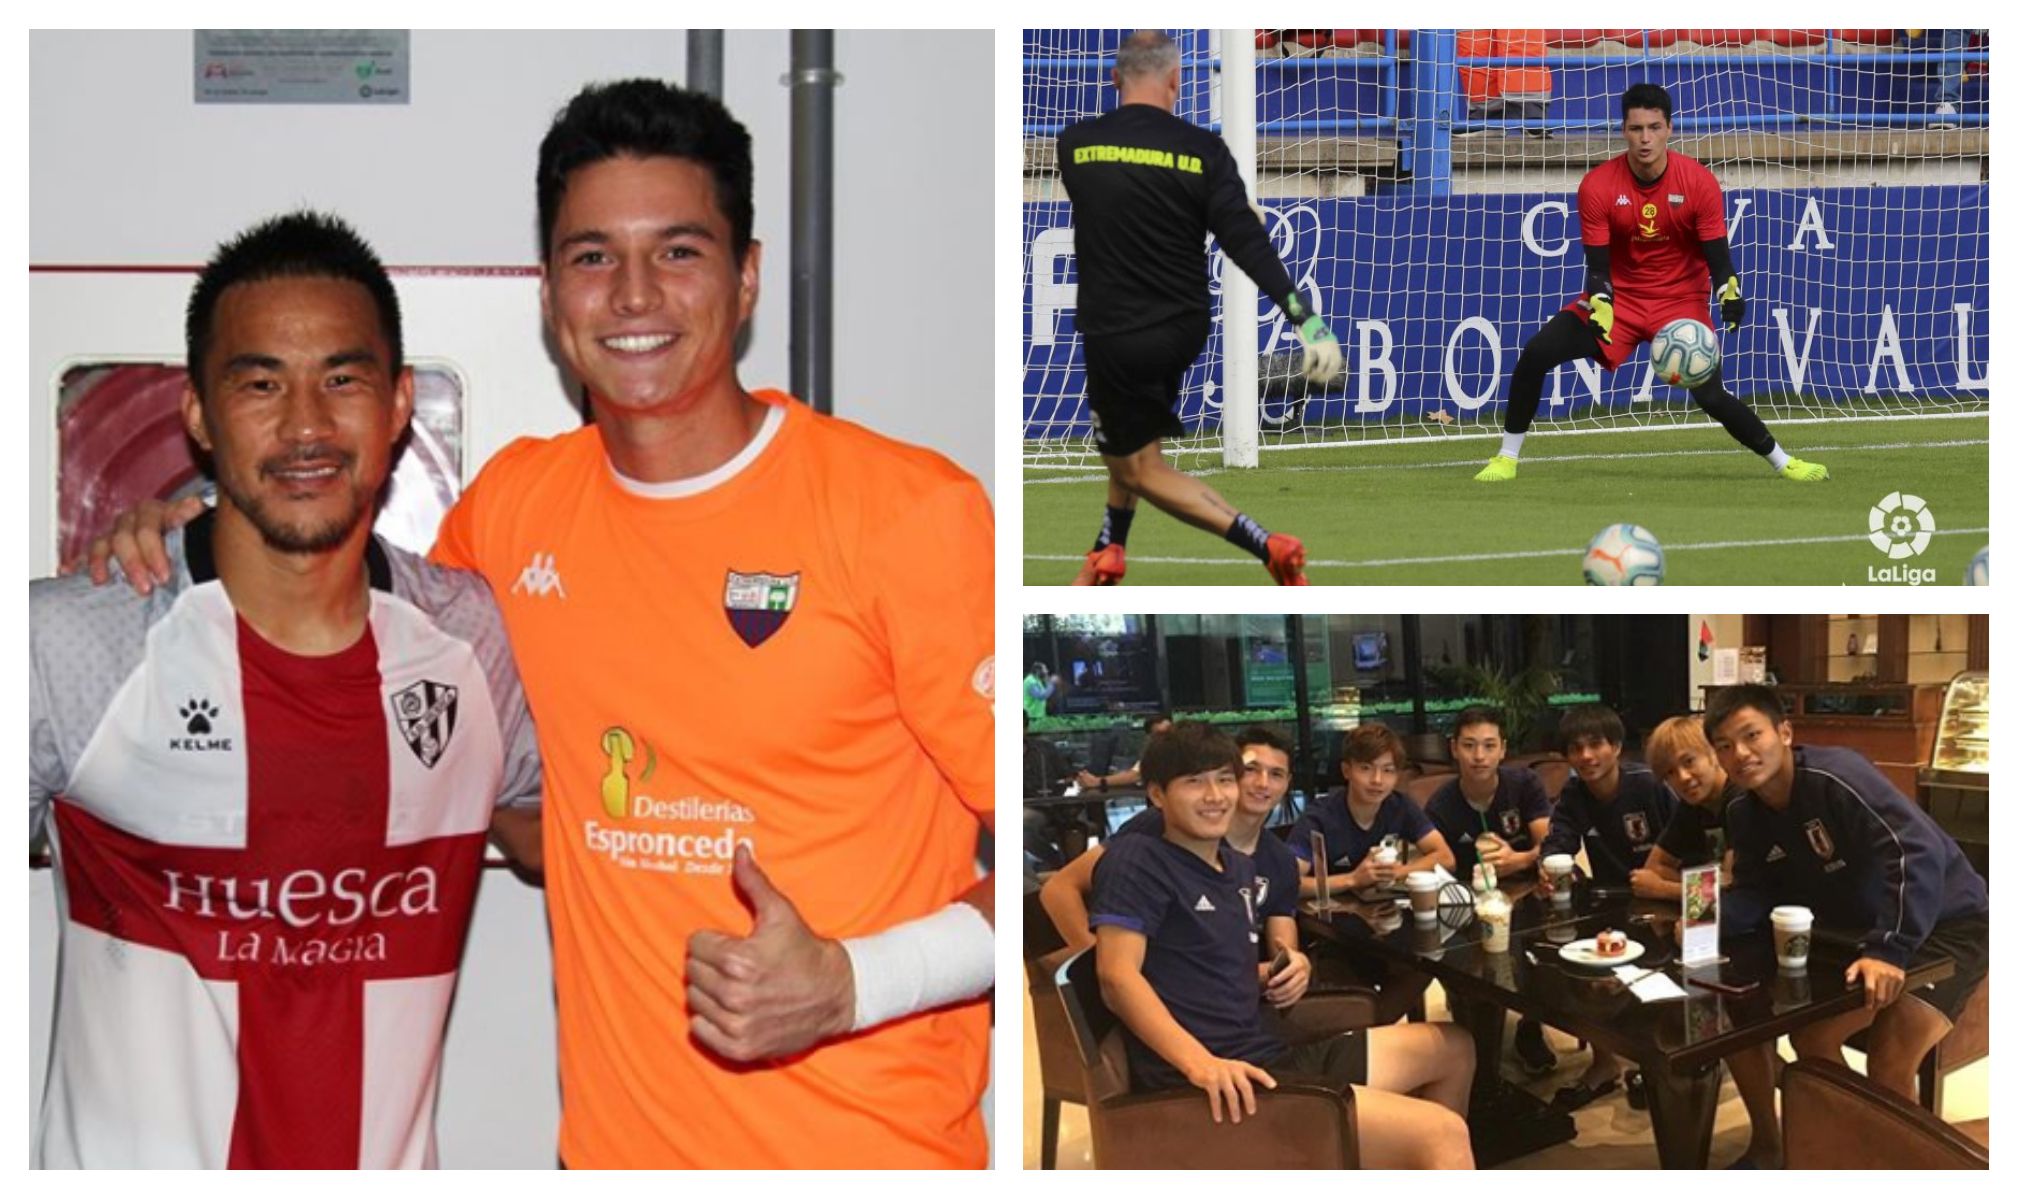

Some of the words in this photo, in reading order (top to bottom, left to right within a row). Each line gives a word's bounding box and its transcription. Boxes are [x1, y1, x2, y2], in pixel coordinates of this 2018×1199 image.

[1074, 145, 1174, 168] EXTREMADURA
[1644, 206, 1656, 216] 28
[1353, 304, 1988, 413] BONVAL
[170, 738, 232, 751] KELME
[161, 865, 440, 927] Huesca
[217, 930, 261, 962] La
